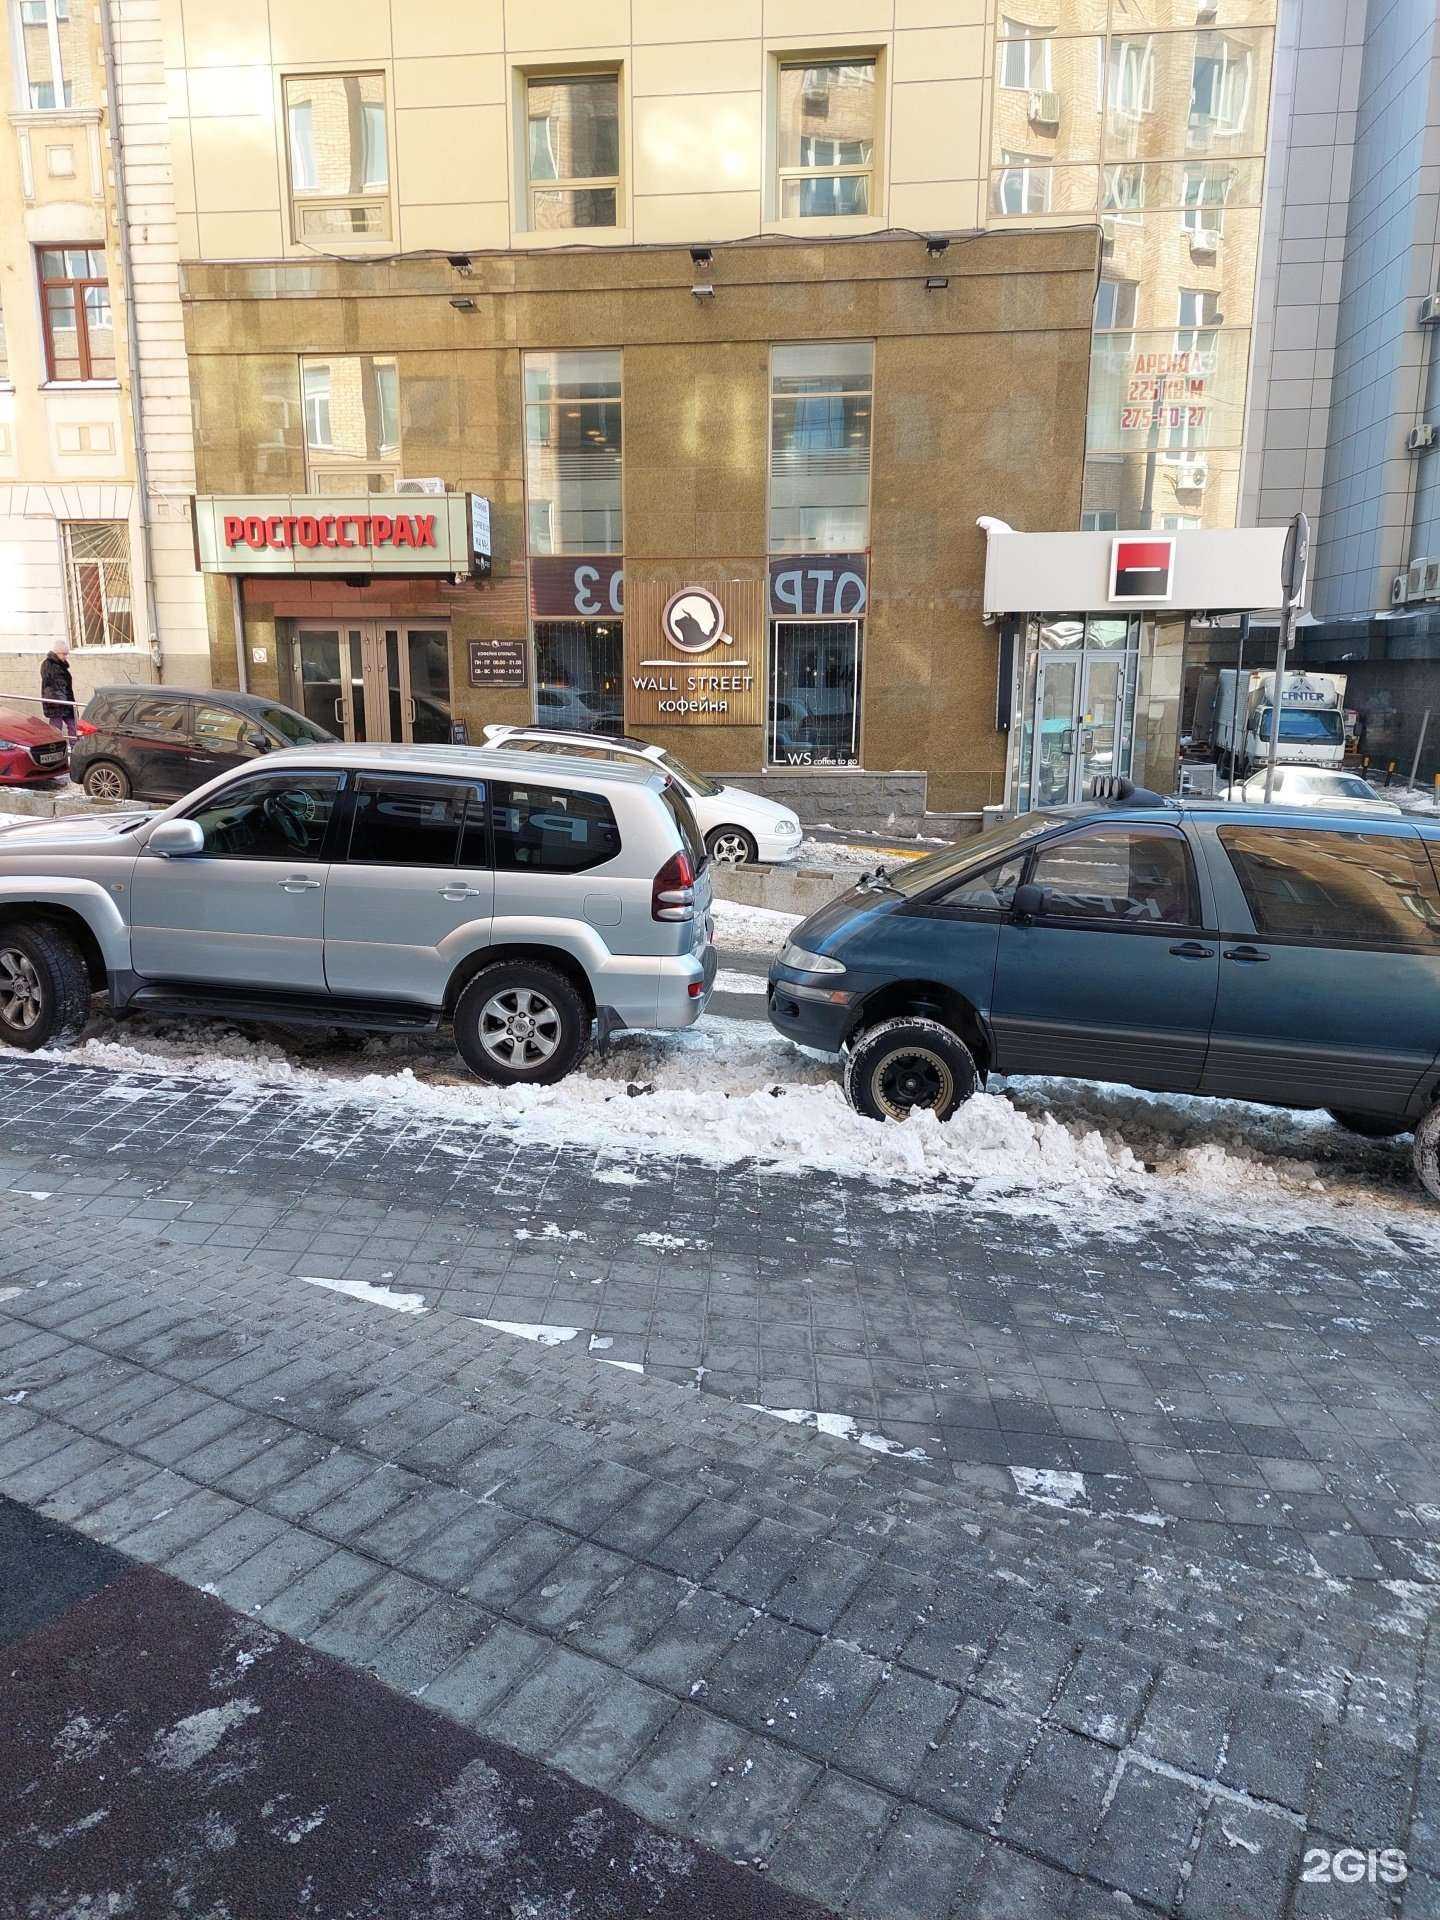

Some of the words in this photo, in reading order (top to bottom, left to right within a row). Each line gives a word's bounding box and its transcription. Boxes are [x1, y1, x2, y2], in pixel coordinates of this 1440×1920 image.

[1135, 353, 1202, 374] АРЕНДА
[223, 514, 437, 548] РОСГОССТРАХ
[632, 676, 678, 690] WALL
[687, 676, 753, 691] STREET
[1281, 691, 1325, 702] CANTER
[658, 696, 728, 715] кофейня
[787, 752, 812, 766] WS
[813, 756, 836, 765] coffee
[838, 757, 846, 765] to
[847, 758, 858, 768] go
